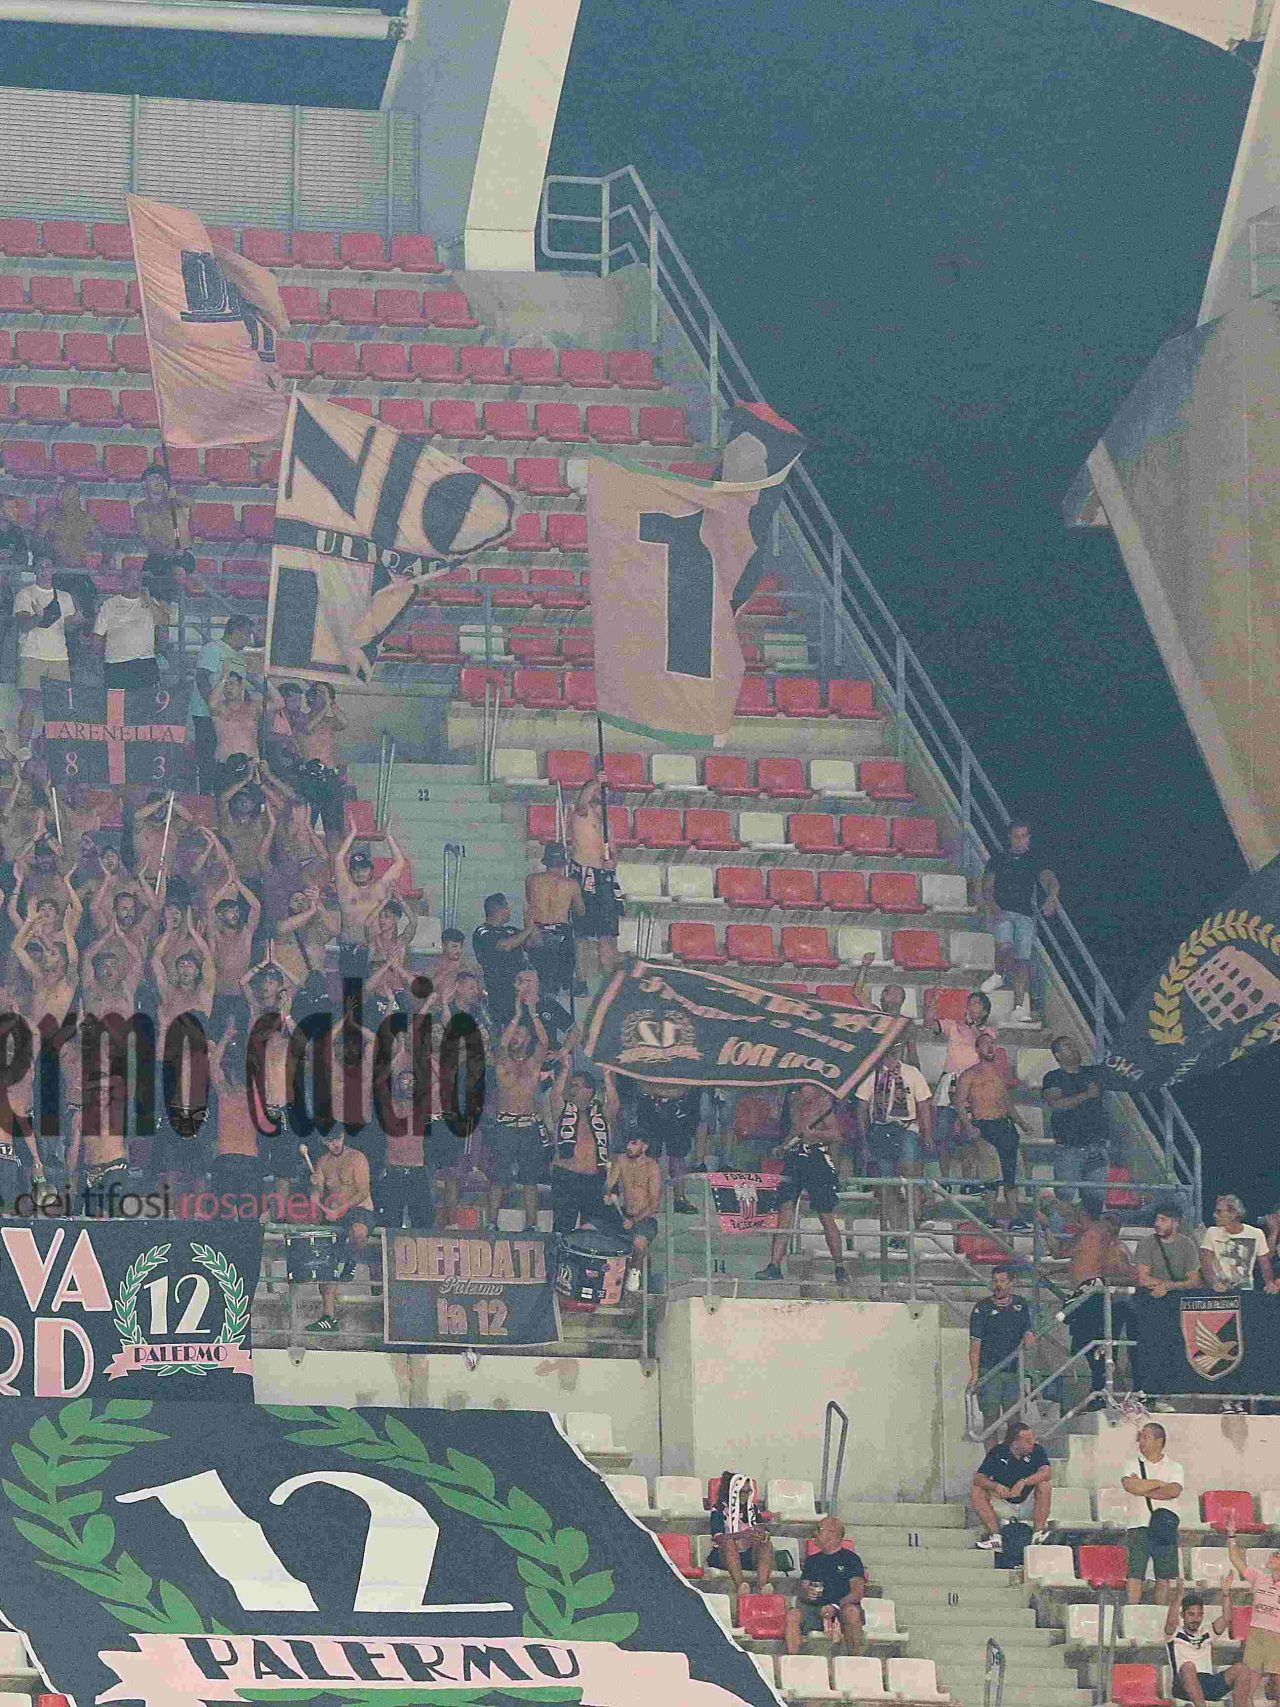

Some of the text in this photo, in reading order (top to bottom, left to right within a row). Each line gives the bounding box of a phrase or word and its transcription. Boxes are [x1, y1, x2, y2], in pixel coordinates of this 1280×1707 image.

[155, 690, 170, 713] 9
[60, 722, 175, 742] ARENELLA
[65, 751, 166, 779] 8 3
[723, 1173, 763, 1183] FORZA
[394, 1237, 547, 1279] DIFFIDATI
[439, 1276, 504, 1296] Palermo
[143, 1274, 211, 1335] 12
[436, 1297, 508, 1336] la 12
[134, 1345, 228, 1364] PALERMO
[115, 1469, 514, 1614] 12
[907, 1533, 918, 1547] 11
[947, 1593, 959, 1607] 10
[178, 1637, 580, 1683] PALERMO
